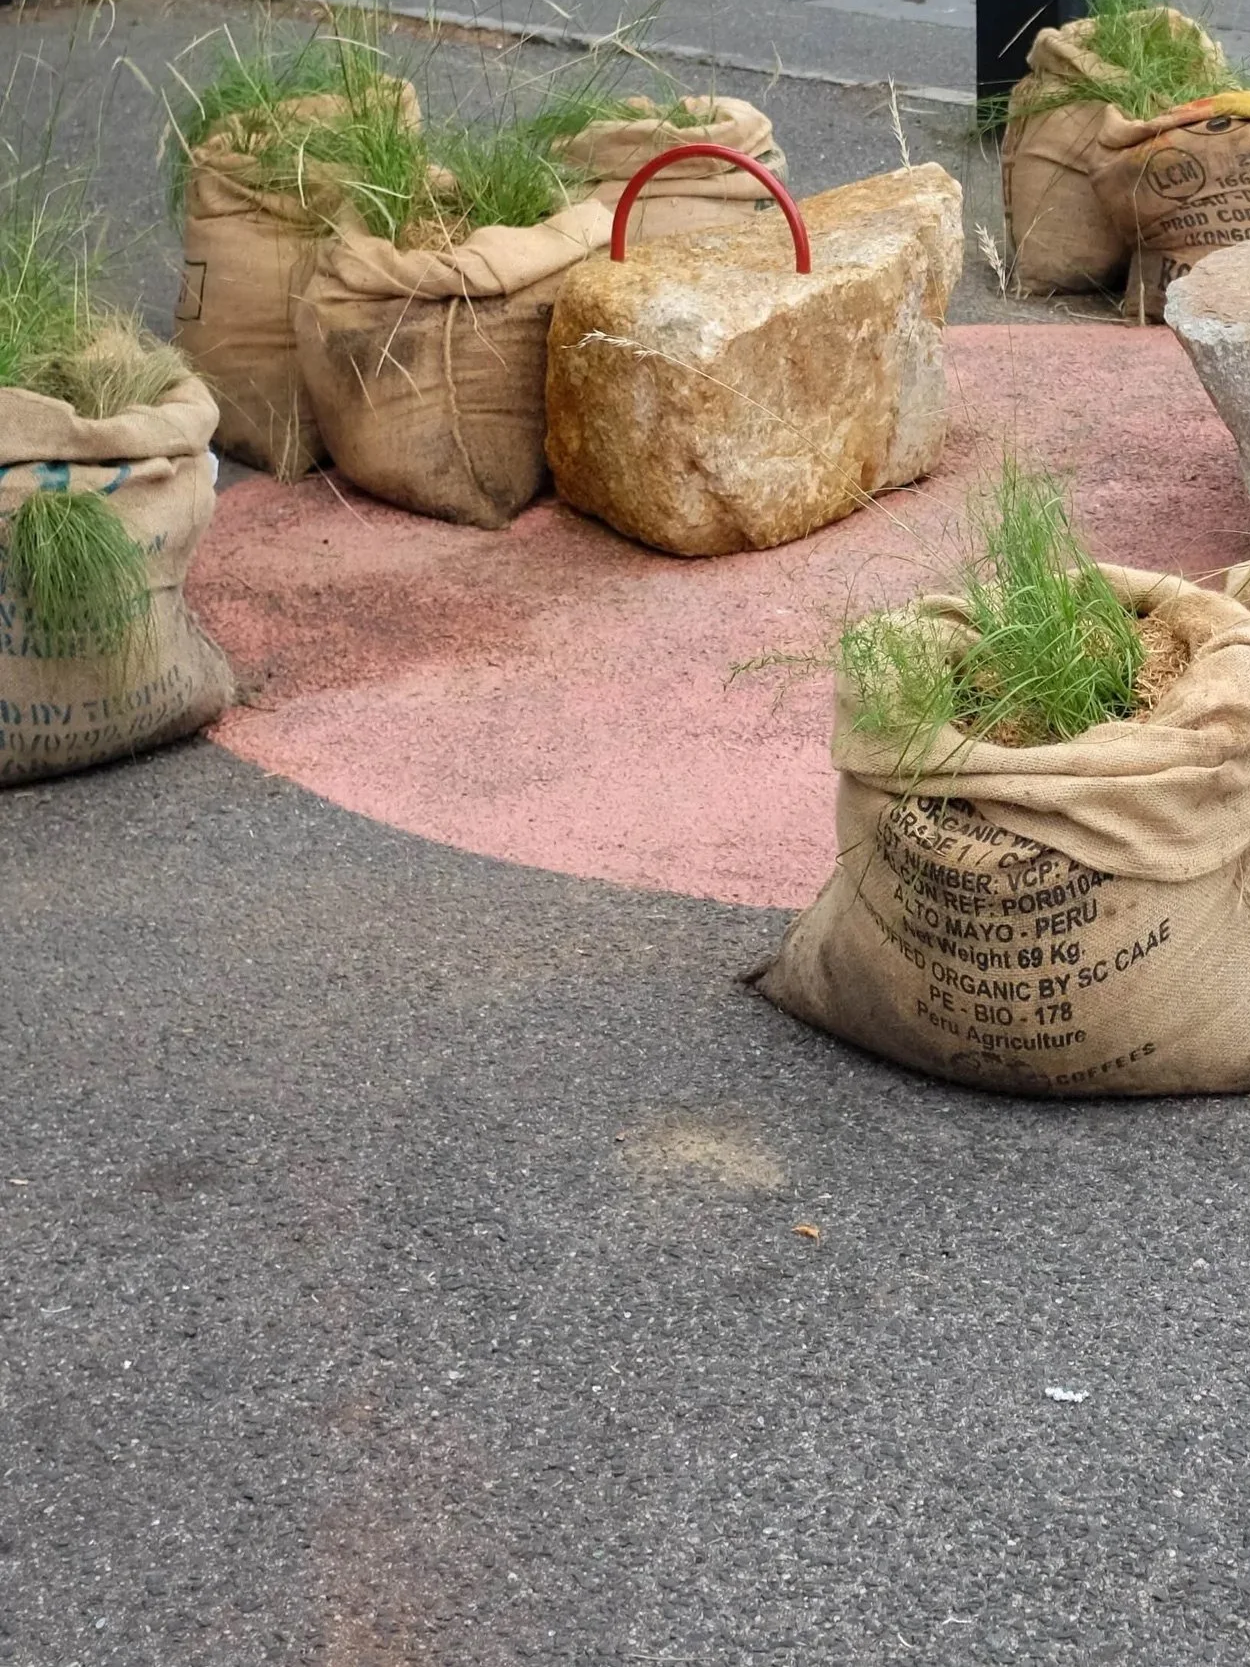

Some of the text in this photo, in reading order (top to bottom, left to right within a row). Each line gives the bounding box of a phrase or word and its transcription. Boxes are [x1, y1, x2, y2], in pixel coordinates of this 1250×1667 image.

[1154, 160, 1197, 191] LCM
[1160, 212, 1209, 233] PROD
[894, 884, 939, 929] ALTO
[945, 916, 1014, 943] MAYO
[1035, 898, 1097, 939] PERU
[931, 961, 1031, 1002] ORGANIC
[1038, 974, 1071, 1000] BY
[1077, 959, 1109, 989] SC
[1114, 917, 1170, 972] CAAE
[936, 935, 1011, 971] Weight
[1017, 946, 1043, 969] 69
[917, 999, 1088, 1053] Peru Agriculture
[929, 984, 955, 1014] PE
[974, 1002, 1014, 1026] BIO
[1034, 1001, 1073, 1026] 178
[1055, 1042, 1157, 1085] COFFEES
